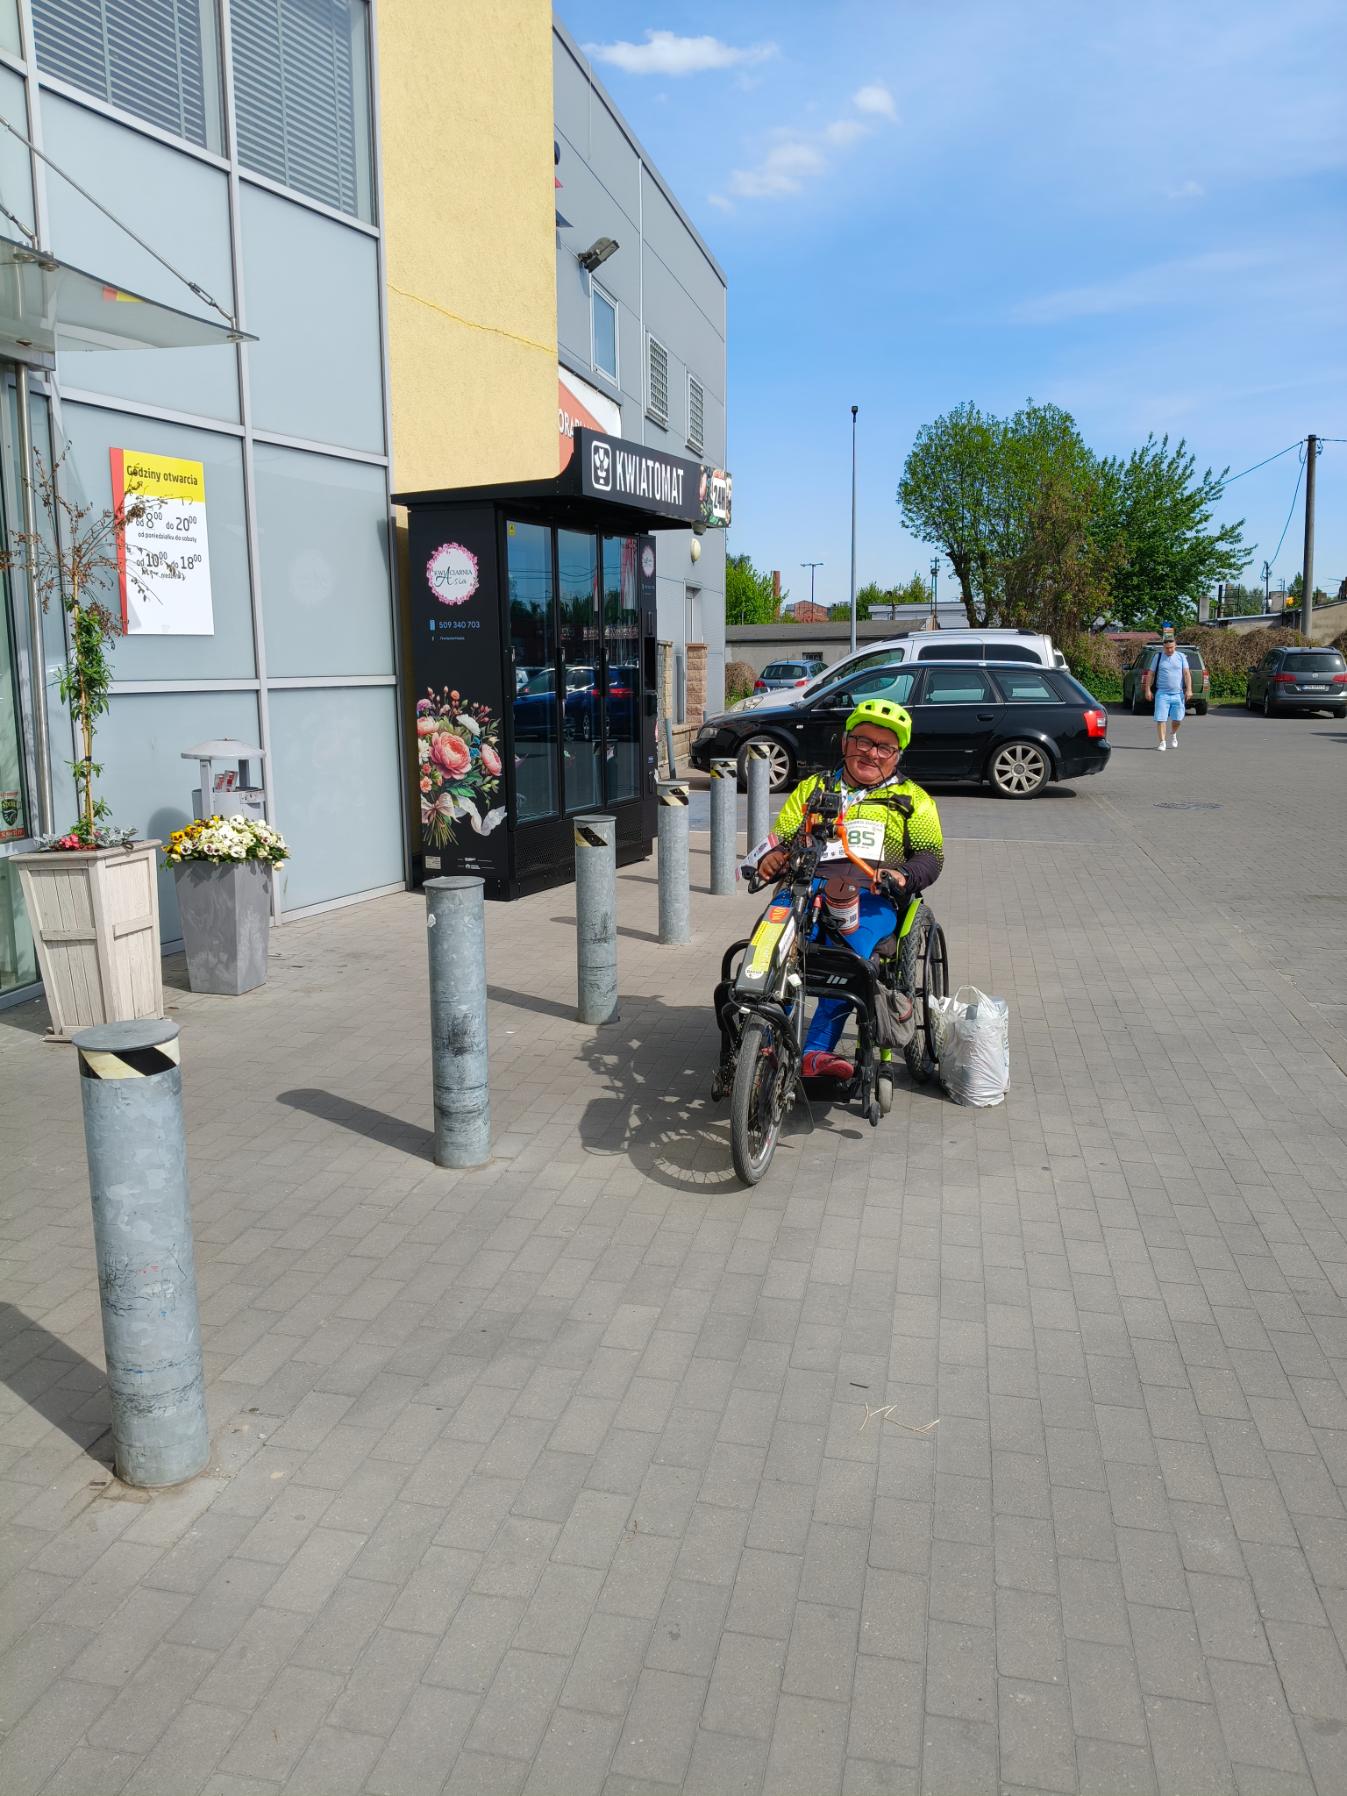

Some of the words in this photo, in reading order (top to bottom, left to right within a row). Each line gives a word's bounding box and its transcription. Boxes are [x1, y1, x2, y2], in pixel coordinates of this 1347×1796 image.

[126, 465, 161, 482] Godziny
[163, 472, 198, 486] otwarcia
[616, 450, 684, 506] KWIATOMAT
[166, 521, 174, 530] do
[136, 559, 145, 567] od
[439, 620, 452, 629] 509
[453, 620, 466, 629] 340
[467, 620, 480, 629] 703
[848, 830, 875, 846] 85
